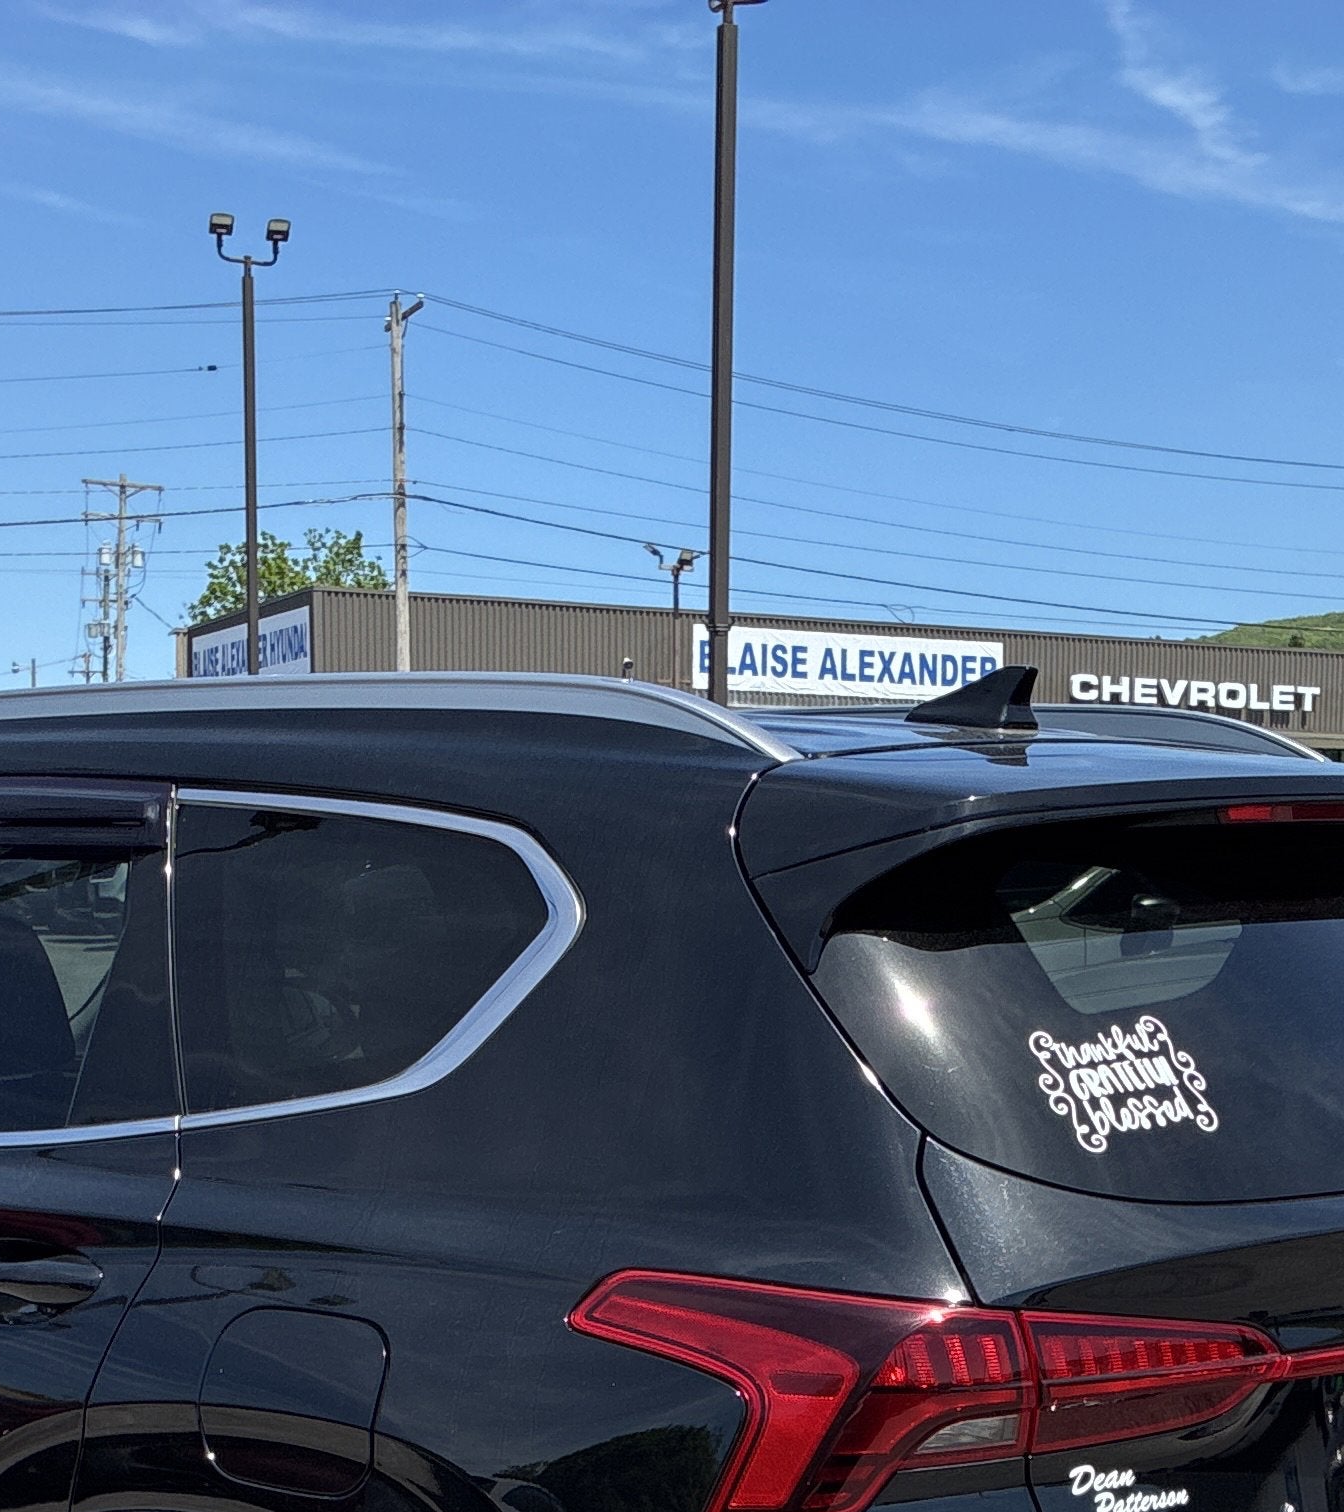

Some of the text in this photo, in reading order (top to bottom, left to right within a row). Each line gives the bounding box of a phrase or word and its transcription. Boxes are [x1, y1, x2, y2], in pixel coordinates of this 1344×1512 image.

[222, 633, 269, 677] ALEXAER
[818, 647, 998, 688] ALEXANDER
[1070, 673, 1321, 712] CHEVROLET
[1068, 1464, 1136, 1497] Dean
